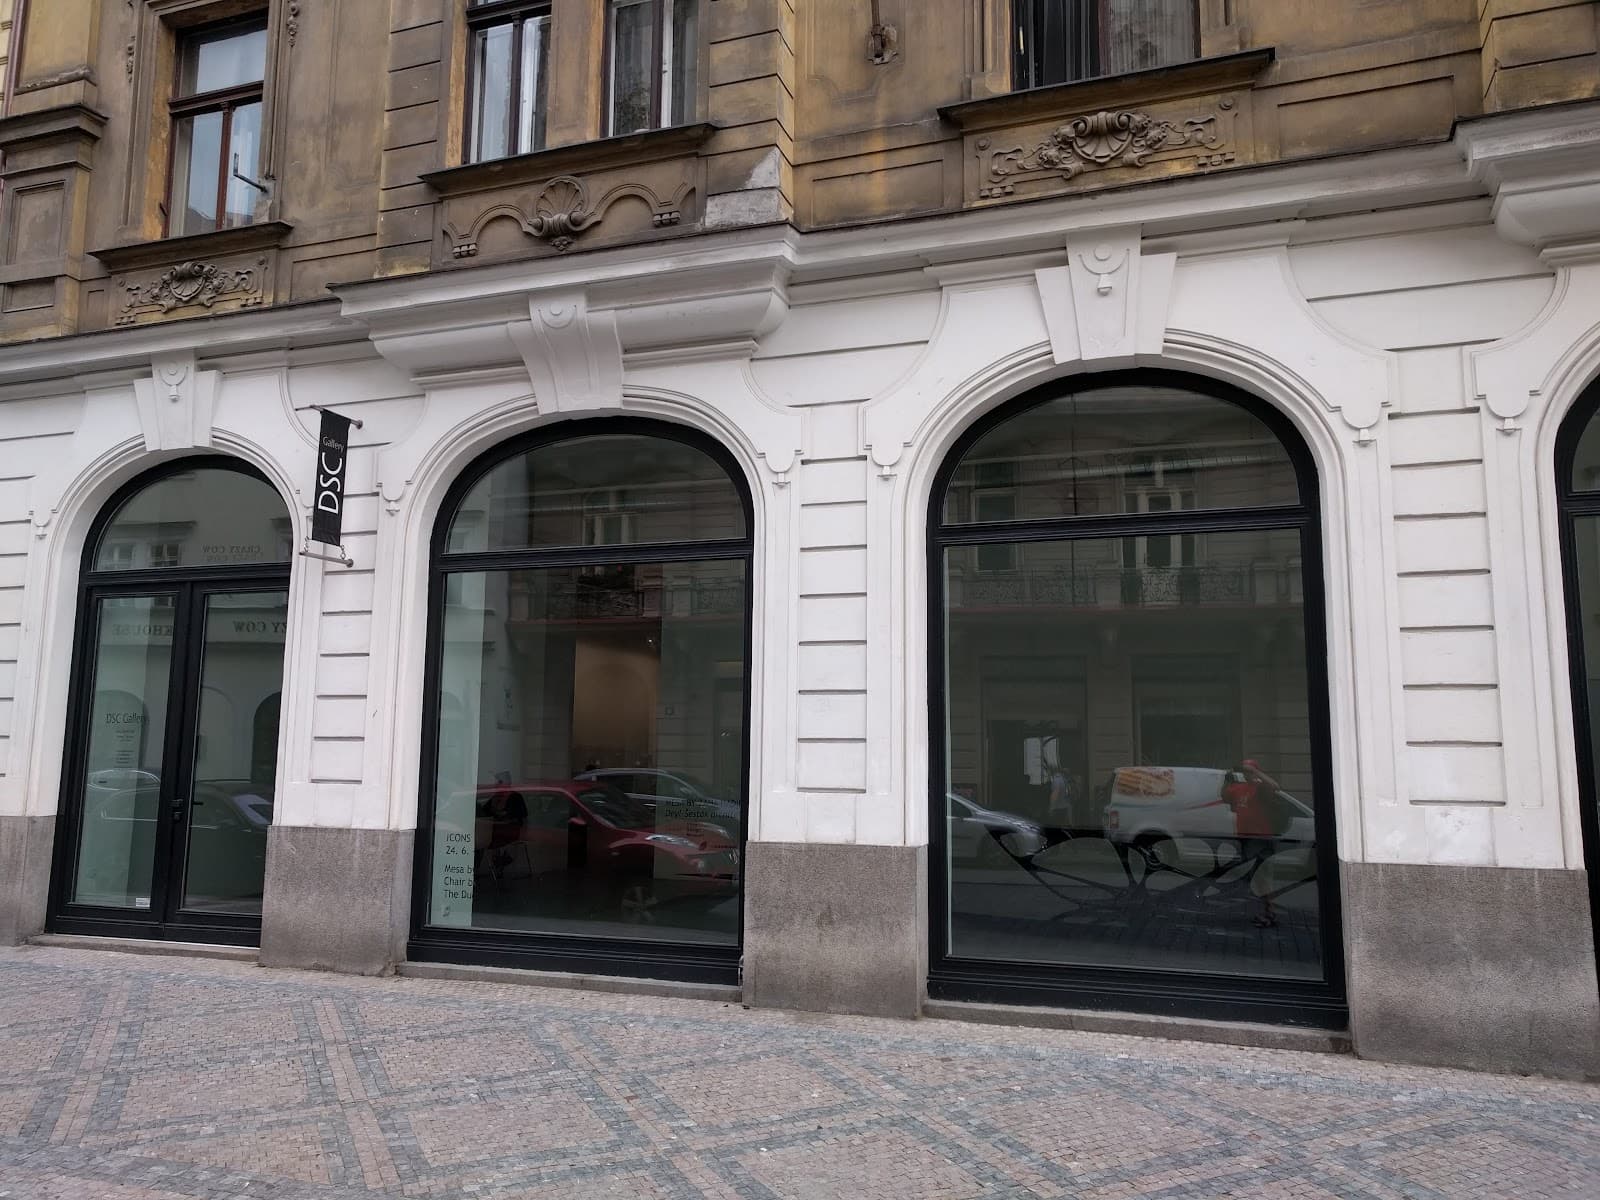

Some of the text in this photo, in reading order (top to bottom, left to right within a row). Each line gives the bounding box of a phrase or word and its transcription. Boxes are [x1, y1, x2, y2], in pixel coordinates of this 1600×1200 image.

[322, 436, 345, 453] Gallery
[318, 452, 343, 514] DSC
[446, 833, 471, 843] ICONS
[446, 845, 469, 855] 24. 6.
[444, 864, 465, 874] Mesa
[444, 876, 466, 886] Chair
[444, 889, 459, 899] The
